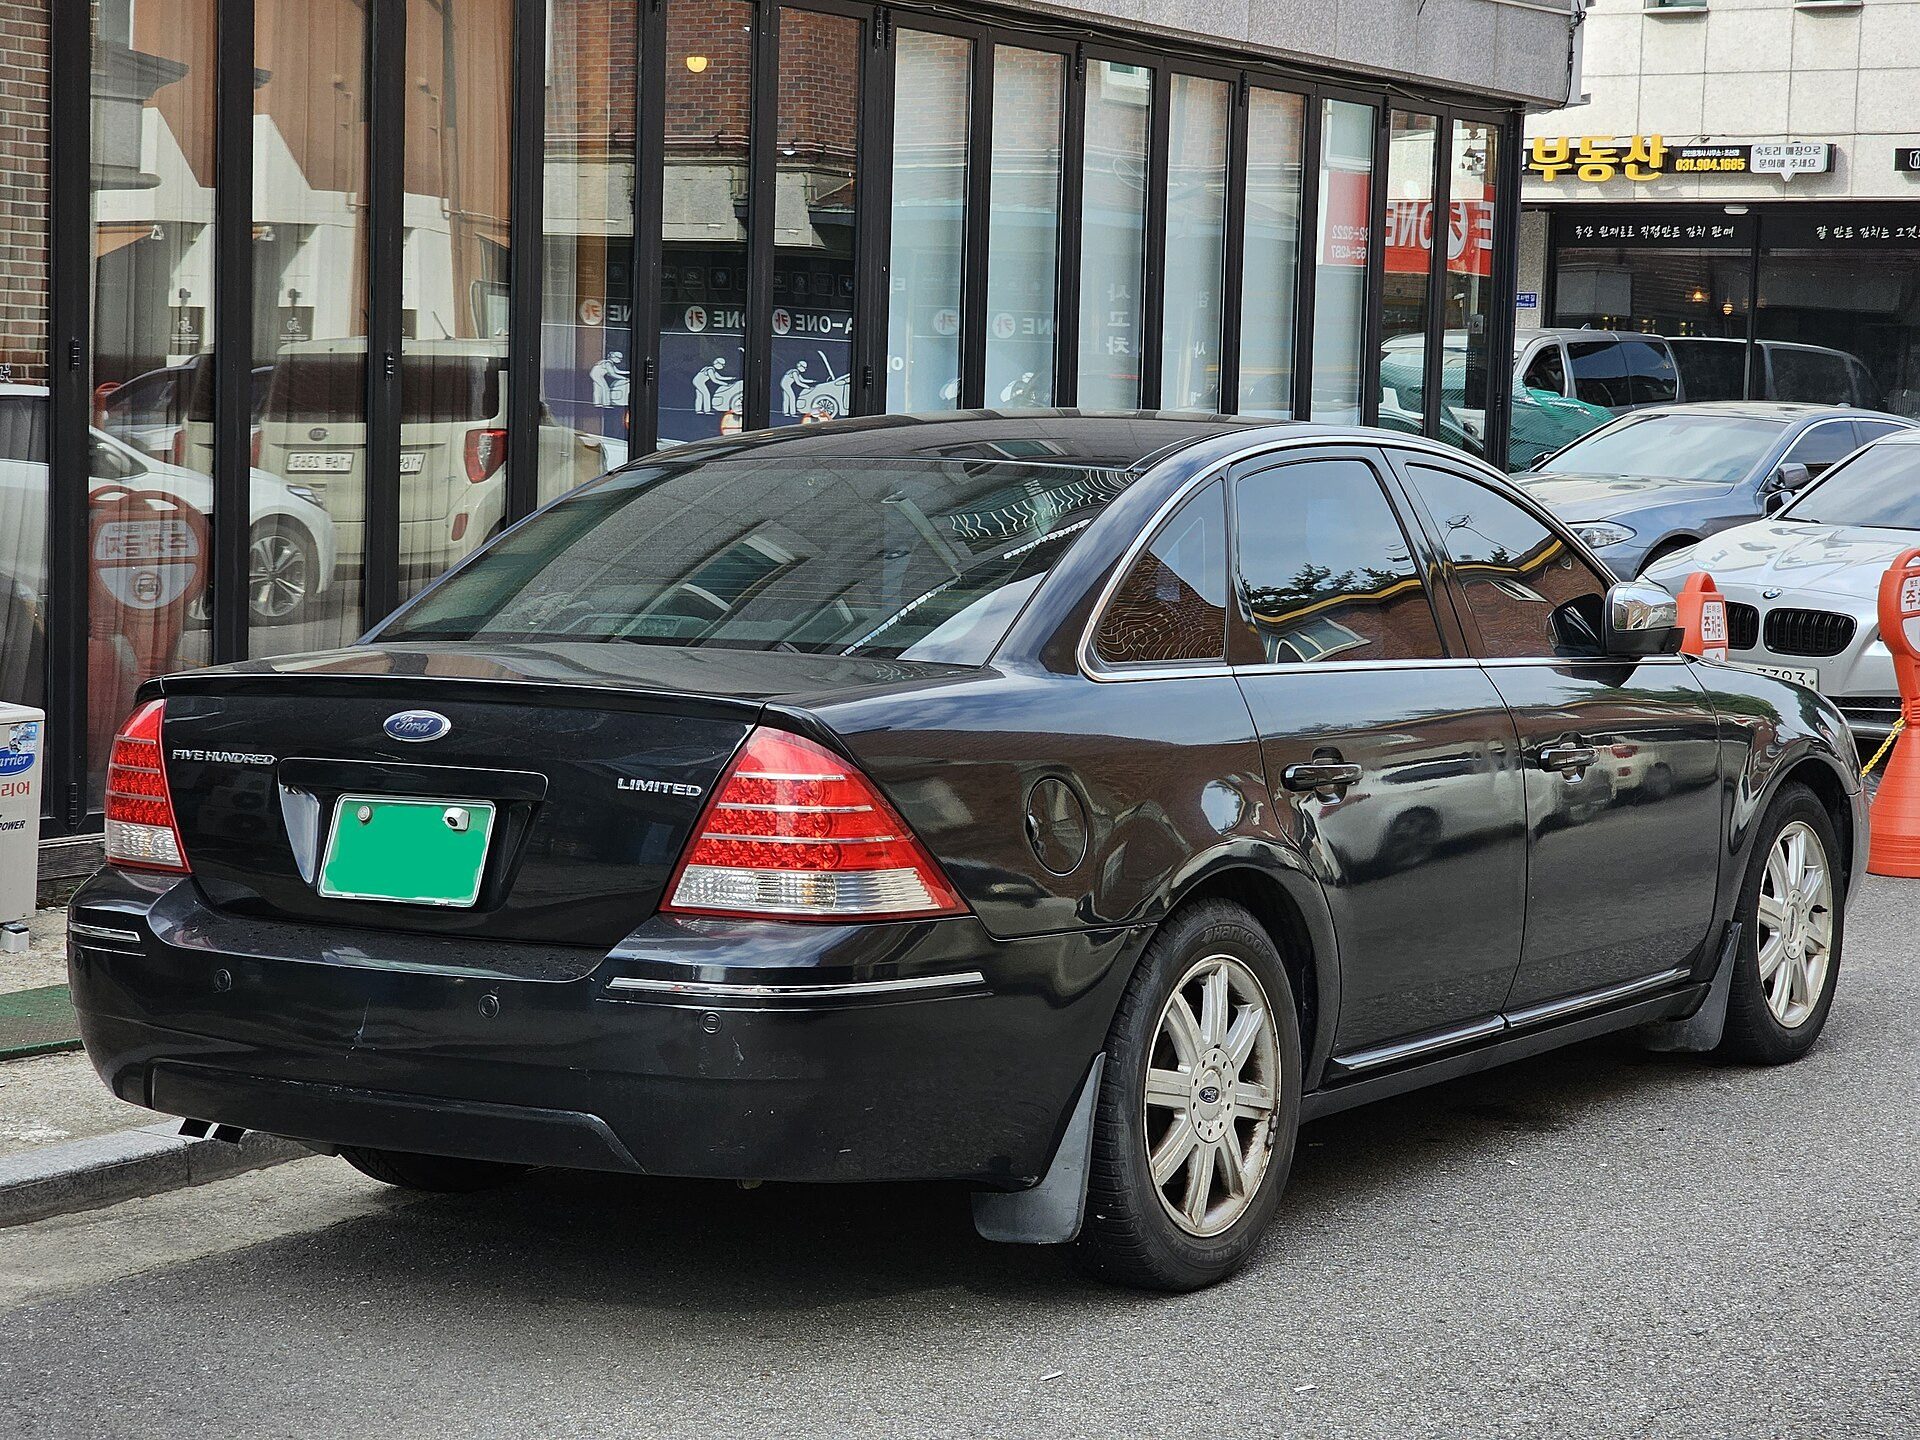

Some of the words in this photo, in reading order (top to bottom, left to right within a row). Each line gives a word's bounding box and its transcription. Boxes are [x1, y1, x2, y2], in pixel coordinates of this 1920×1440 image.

[1528, 133, 1669, 182] 부동산
[1785, 145, 1821, 156] 매장으로
[1675, 158, 1746, 171] 031.904.1685
[1759, 159, 1786, 168] 문의해
[1789, 159, 1816, 168] 주세요
[1575, 225, 1594, 239] 국산
[1686, 225, 1706, 238] 김치
[1711, 225, 1735, 239] 판매
[1816, 225, 1828, 240] 잘
[1833, 225, 1854, 239] 만든
[1859, 225, 1890, 239] 김치는
[393, 715, 431, 734] Ford
[172, 749, 204, 761] FIVE
[205, 750, 277, 766] HUNDRED
[1, 780, 30, 797] 리어
[617, 778, 703, 797] LIMITED
